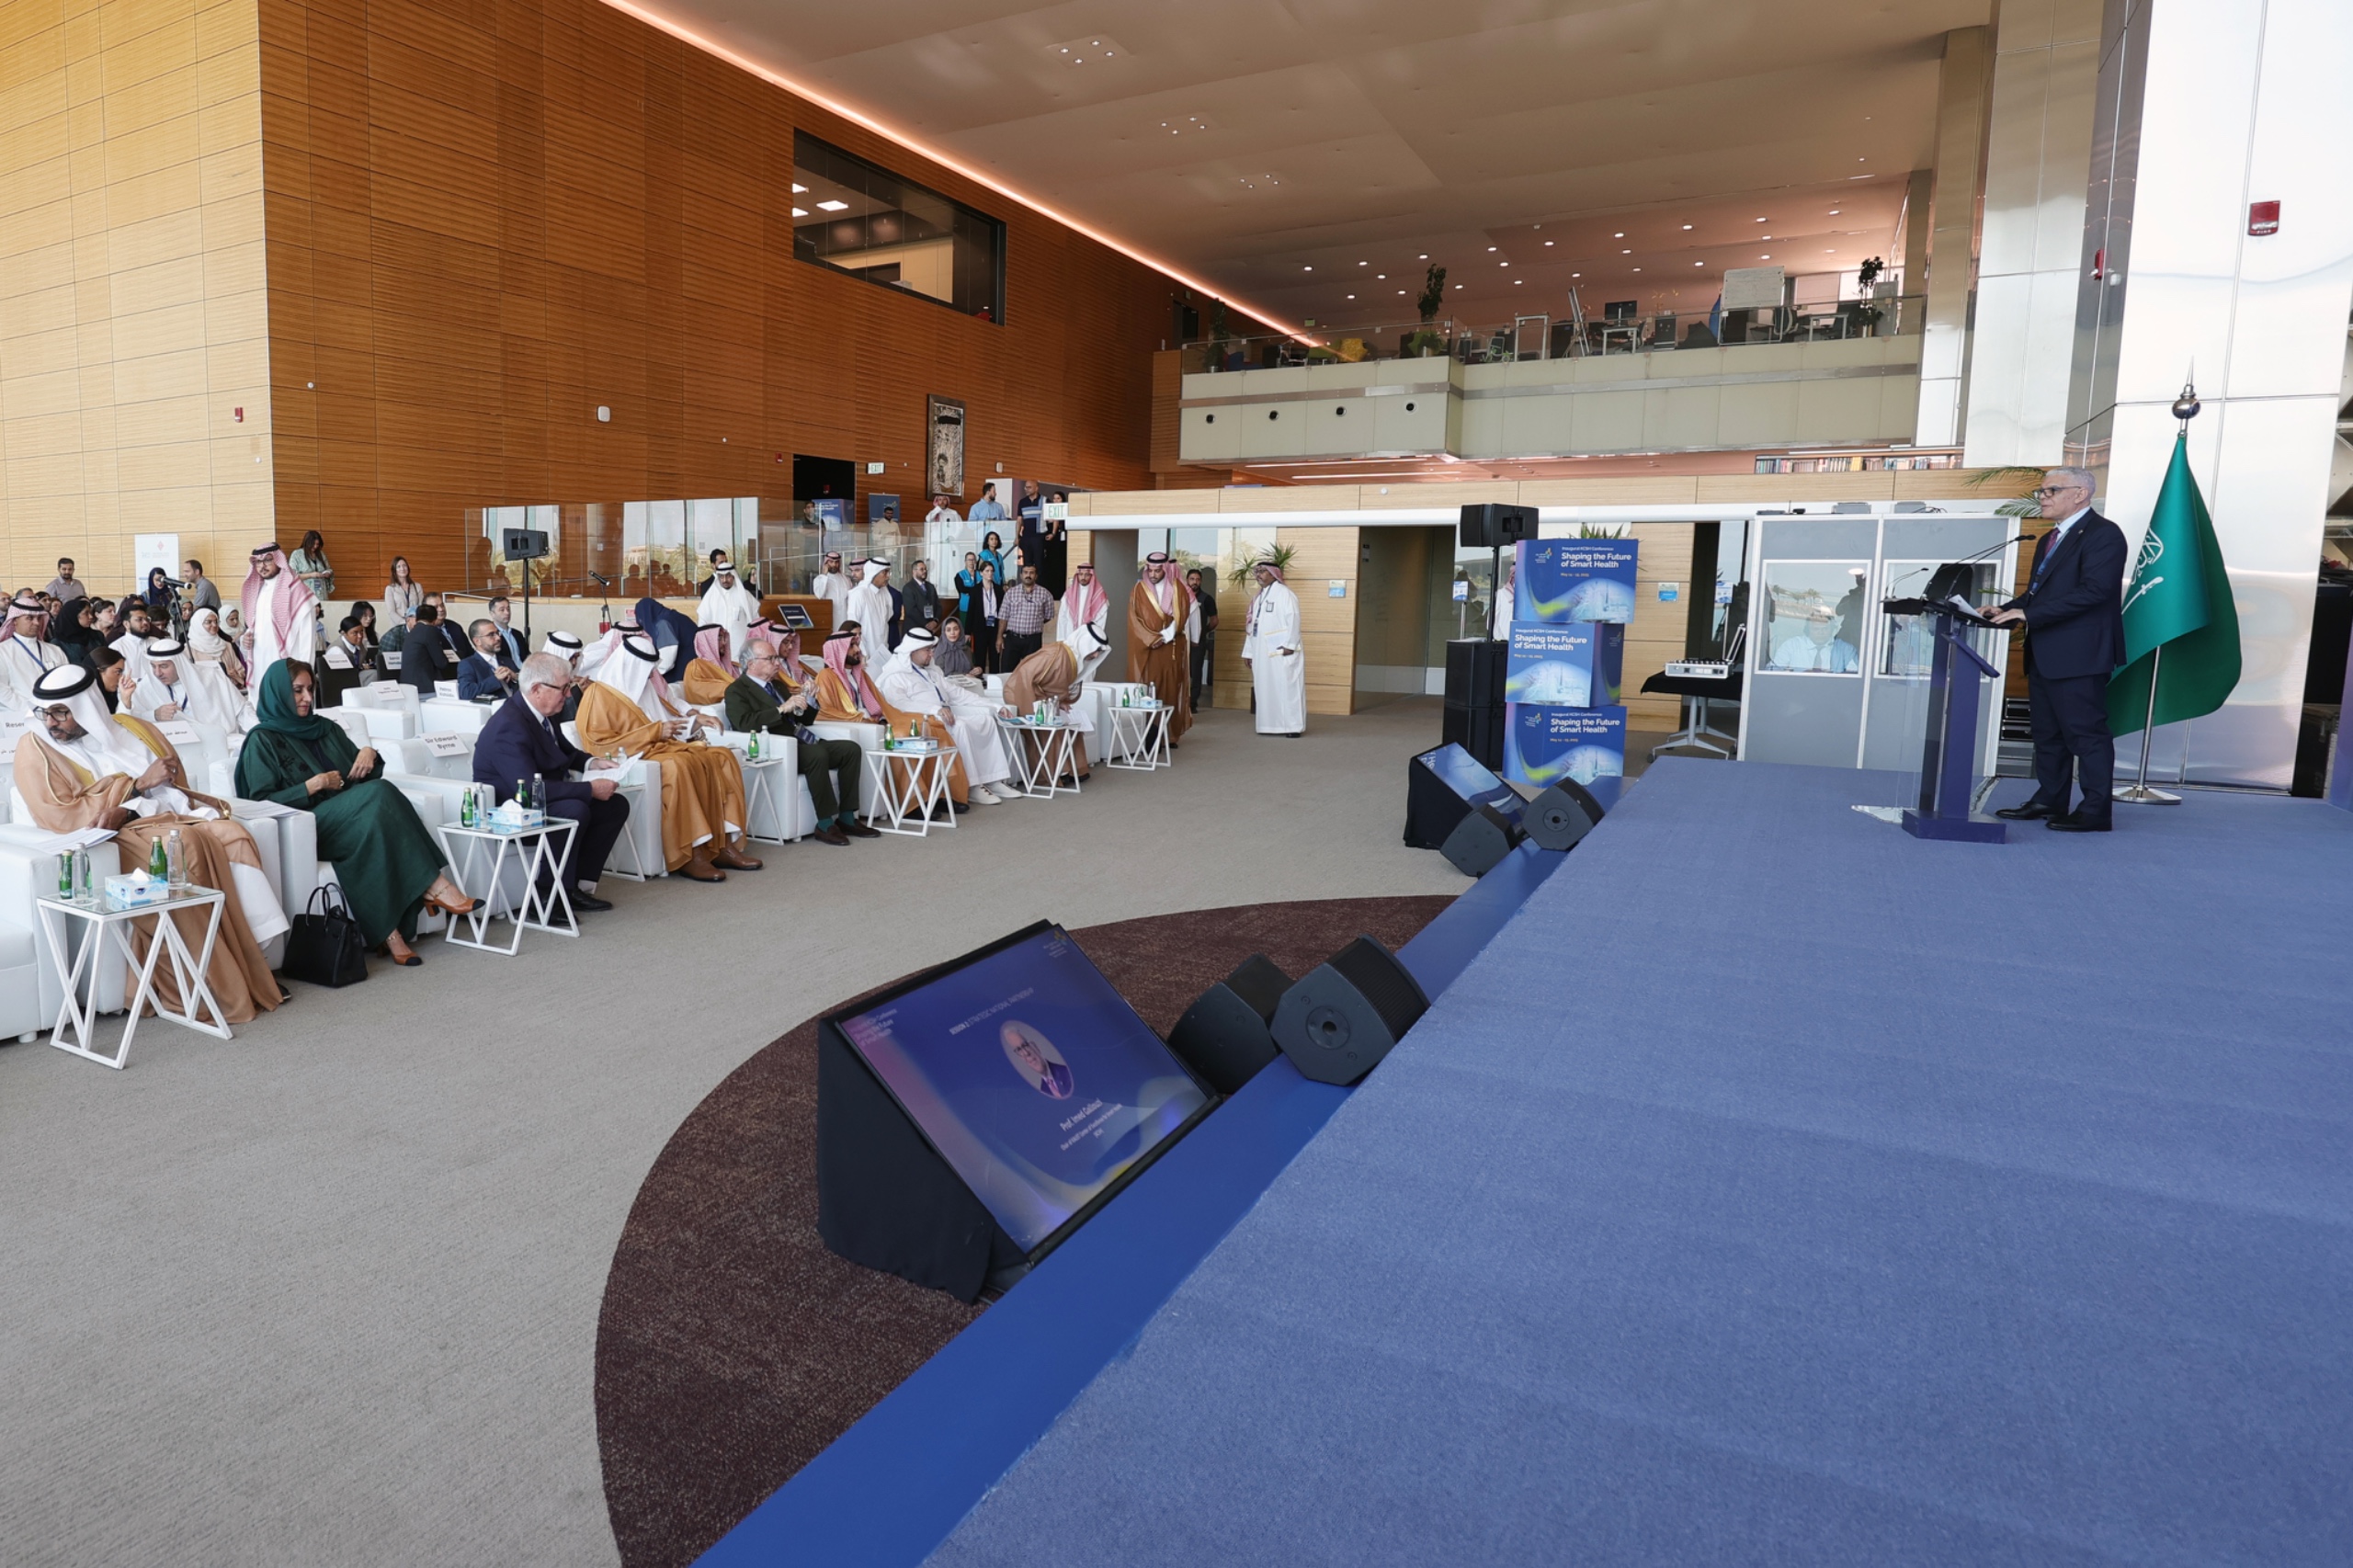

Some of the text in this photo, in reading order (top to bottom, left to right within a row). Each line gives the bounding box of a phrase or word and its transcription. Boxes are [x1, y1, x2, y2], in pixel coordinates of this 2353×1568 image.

[1048, 505, 1064, 518] EXIT
[1561, 552, 1592, 561] Shaping
[1515, 634, 1545, 643] Shaping
[1551, 718, 1581, 726] Shaping
